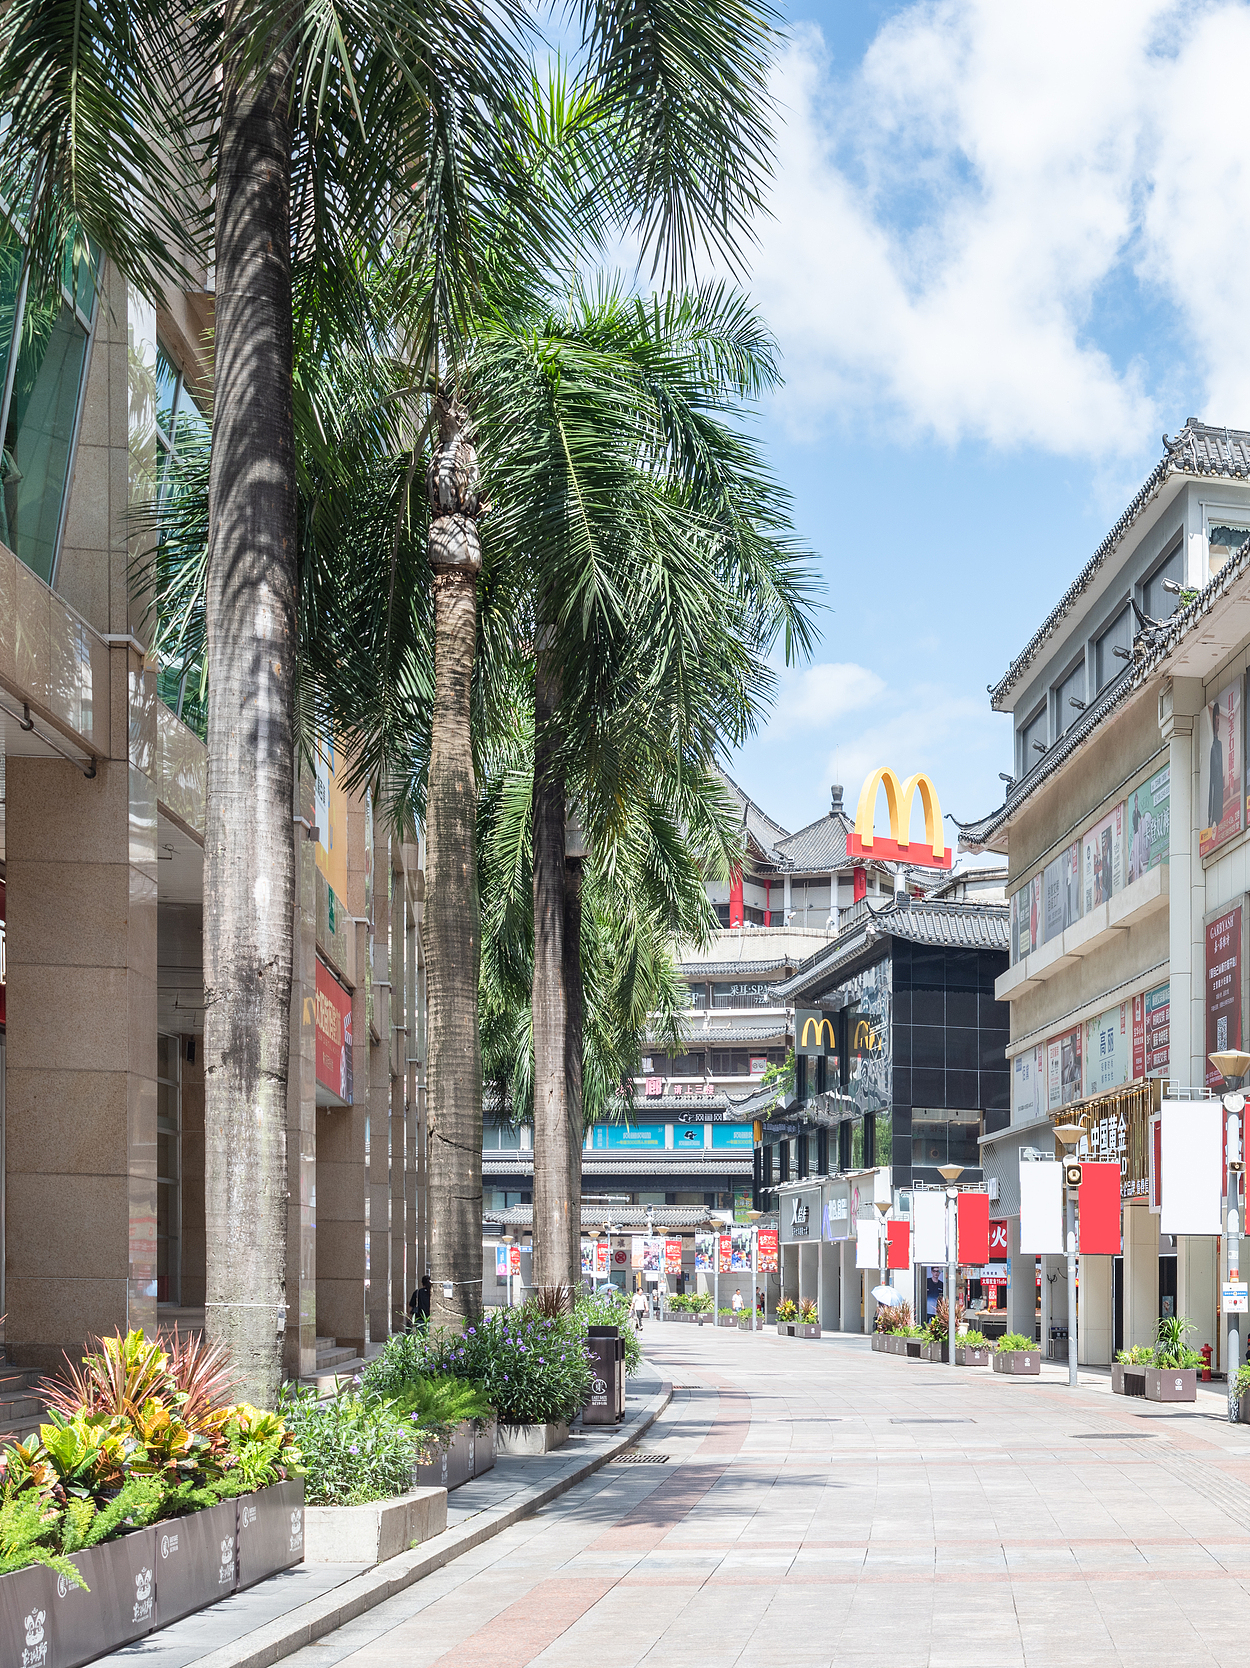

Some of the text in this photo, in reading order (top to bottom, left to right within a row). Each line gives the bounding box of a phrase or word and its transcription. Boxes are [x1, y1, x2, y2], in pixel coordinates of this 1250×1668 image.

[1090, 1112, 1128, 1158] 中国黄金
[990, 1225, 1007, 1248] 火
